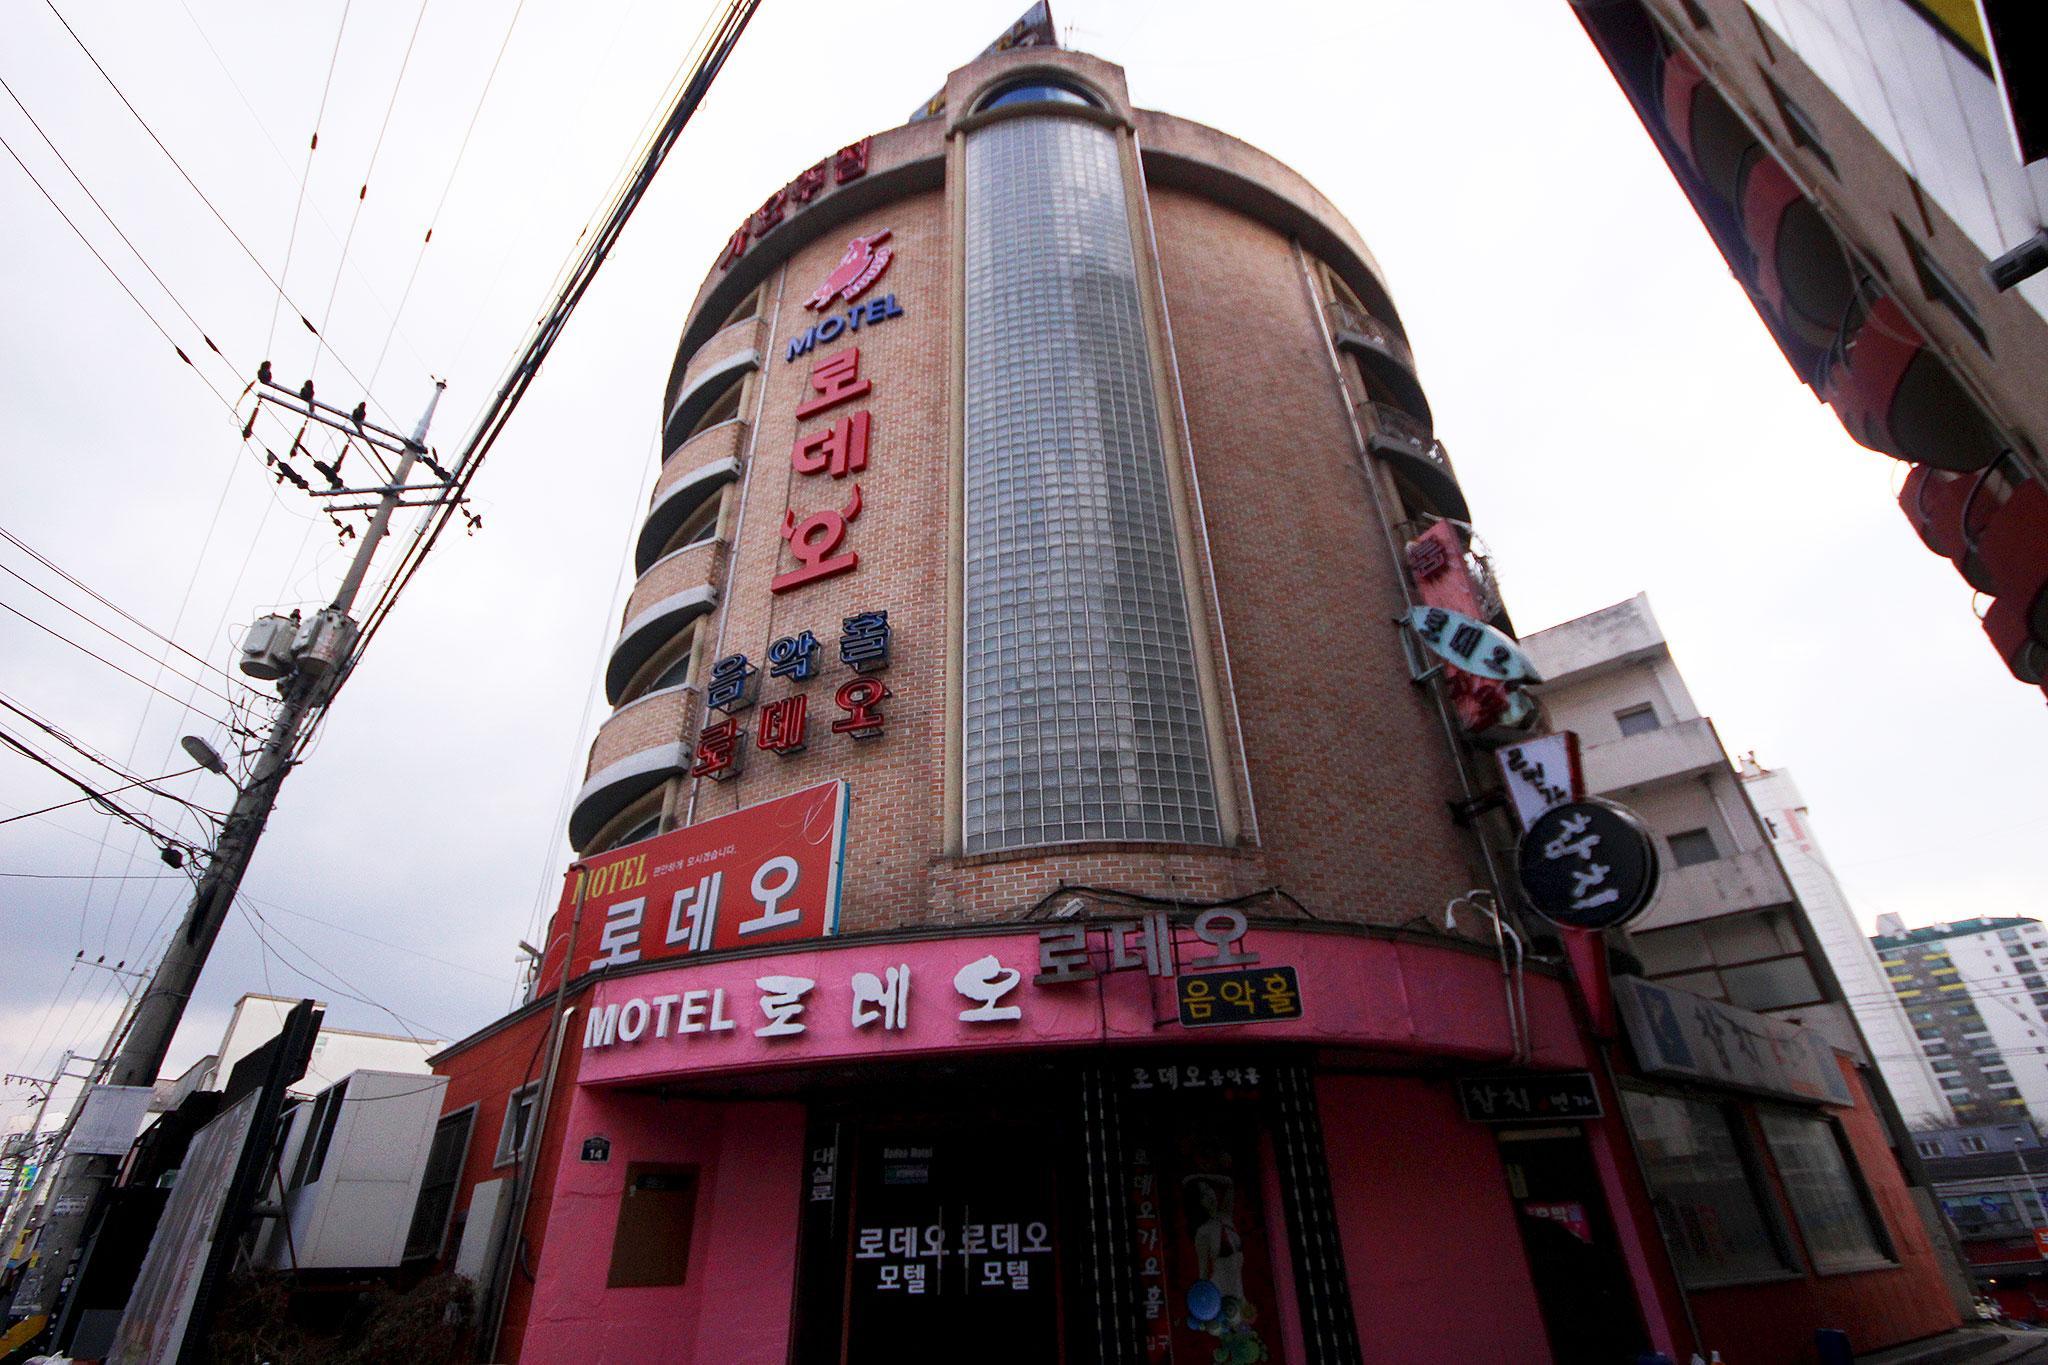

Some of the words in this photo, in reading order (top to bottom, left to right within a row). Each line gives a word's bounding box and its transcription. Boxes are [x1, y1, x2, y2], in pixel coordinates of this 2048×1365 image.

[785, 293, 904, 363] MOTEL
[771, 347, 872, 594] 로데오
[707, 610, 890, 708] 음악홀
[692, 676, 884, 778] 로데오
[588, 855, 801, 970] 로데오
[1034, 908, 1260, 986] 로데오
[582, 987, 736, 1048] MOTEL
[753, 954, 1024, 1038] 로데오
[1183, 973, 1296, 1019] 음악홀
[1129, 1065, 1206, 1091] 로데오
[1208, 1067, 1262, 1087] 음악홀
[589, 1149, 603, 1160] 14
[855, 1223, 950, 1260] 로데오
[958, 1220, 1053, 1257] 로데오
[876, 1262, 926, 1294] 모텔
[981, 1259, 1031, 1291] 모텔
